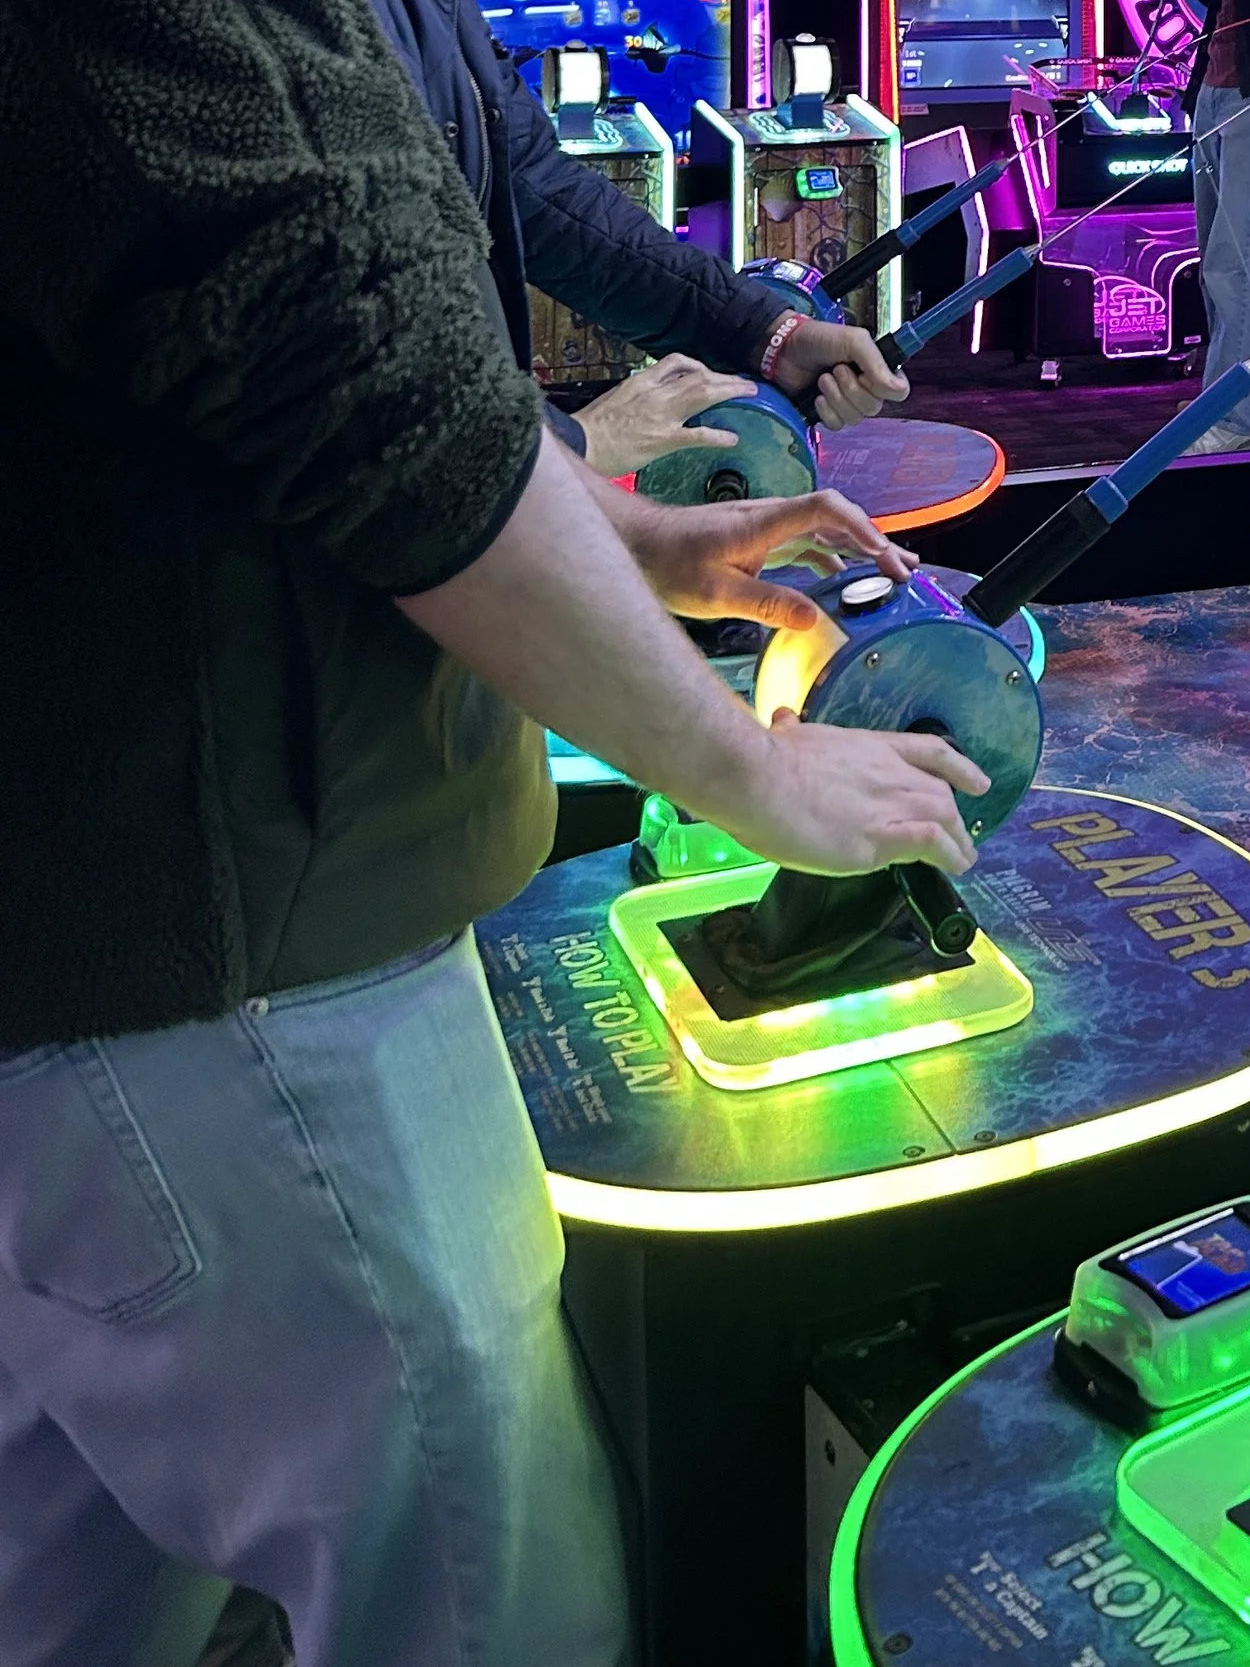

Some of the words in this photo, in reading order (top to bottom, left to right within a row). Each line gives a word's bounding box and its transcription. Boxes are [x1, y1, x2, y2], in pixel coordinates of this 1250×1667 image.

[1107, 159, 1151, 177] QUICK
[760, 317, 799, 373] STRONG
[1108, 314, 1166, 328] GAMES
[551, 930, 621, 989] HOW
[583, 989, 639, 1028] TO
[602, 1028, 683, 1094] PLAY
[1047, 1531, 1232, 1667] HOW
